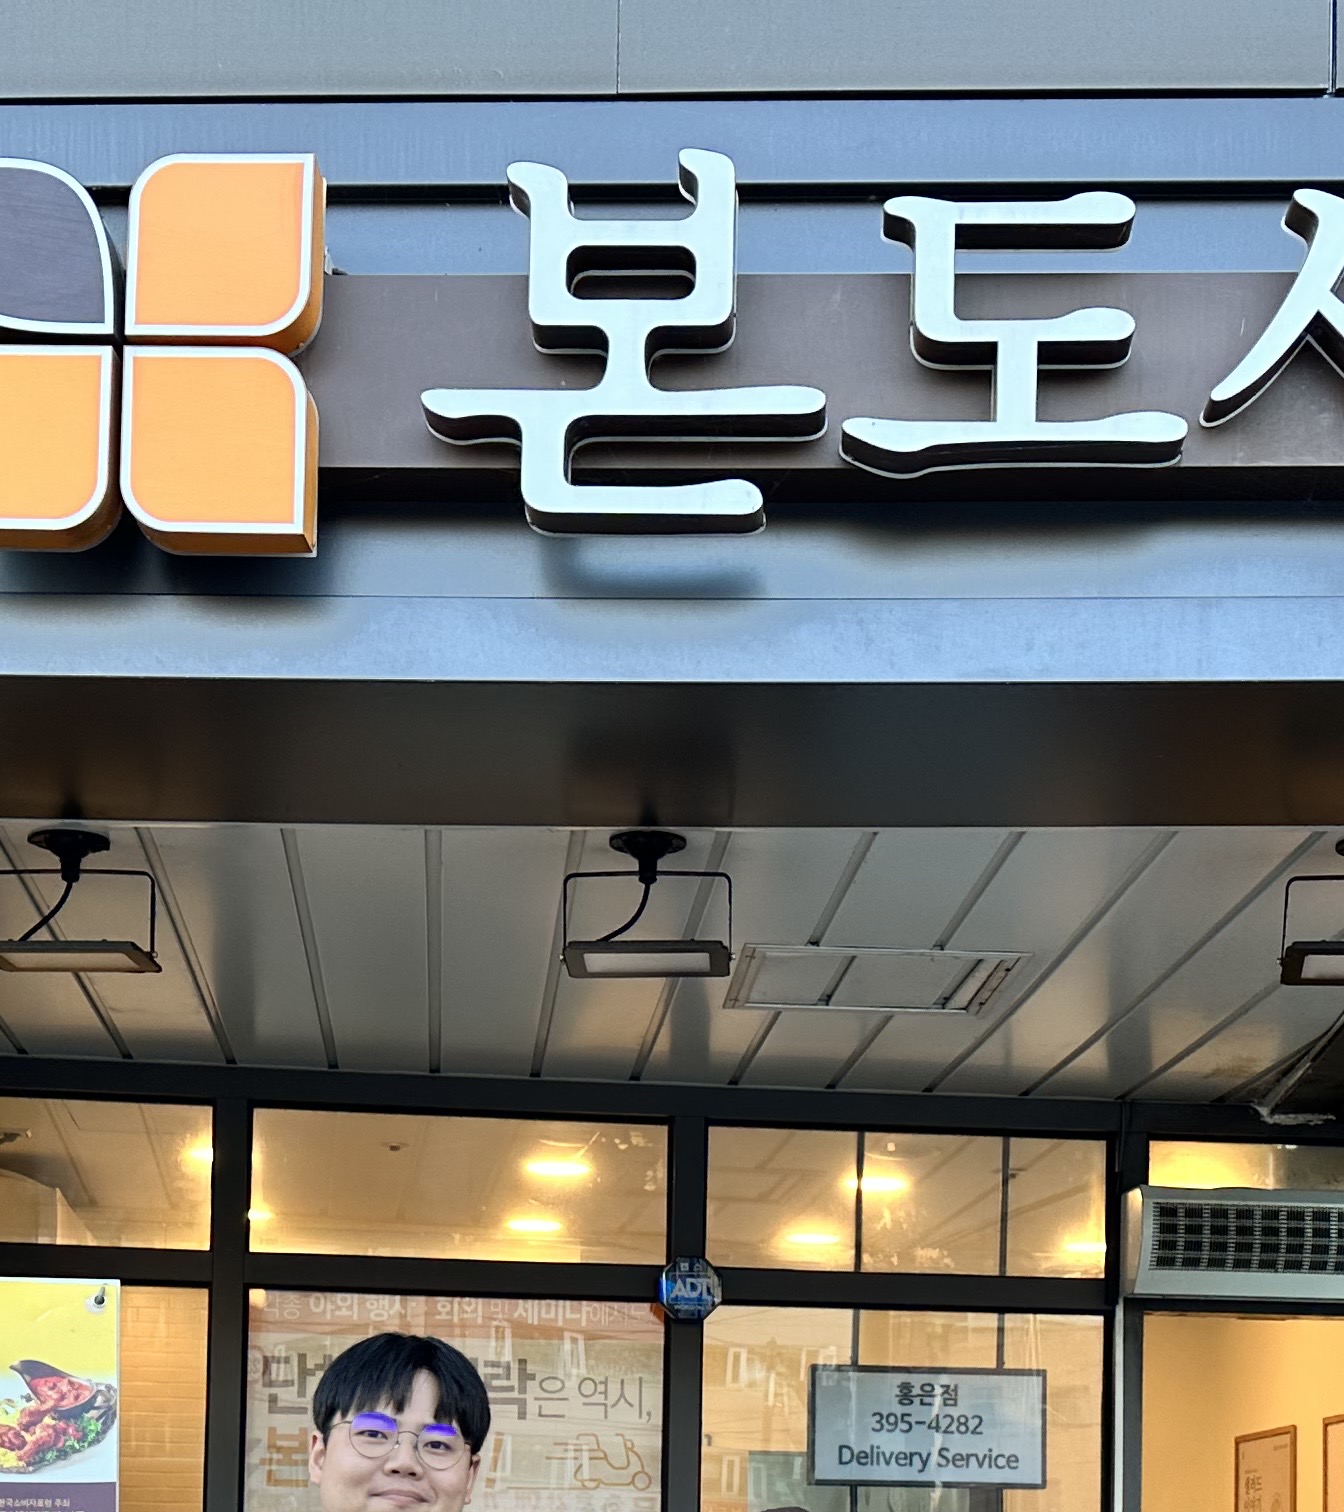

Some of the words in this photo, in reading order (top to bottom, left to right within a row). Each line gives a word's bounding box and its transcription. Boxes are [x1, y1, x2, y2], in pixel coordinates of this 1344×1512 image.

[670, 1277, 712, 1299] ADT
[578, 1375, 652, 1424] 역시,
[895, 1381, 960, 1408] 홍은점
[871, 1412, 984, 1437] 395-4282
[837, 1444, 931, 1474] Delivery
[936, 1447, 1020, 1470] Service
